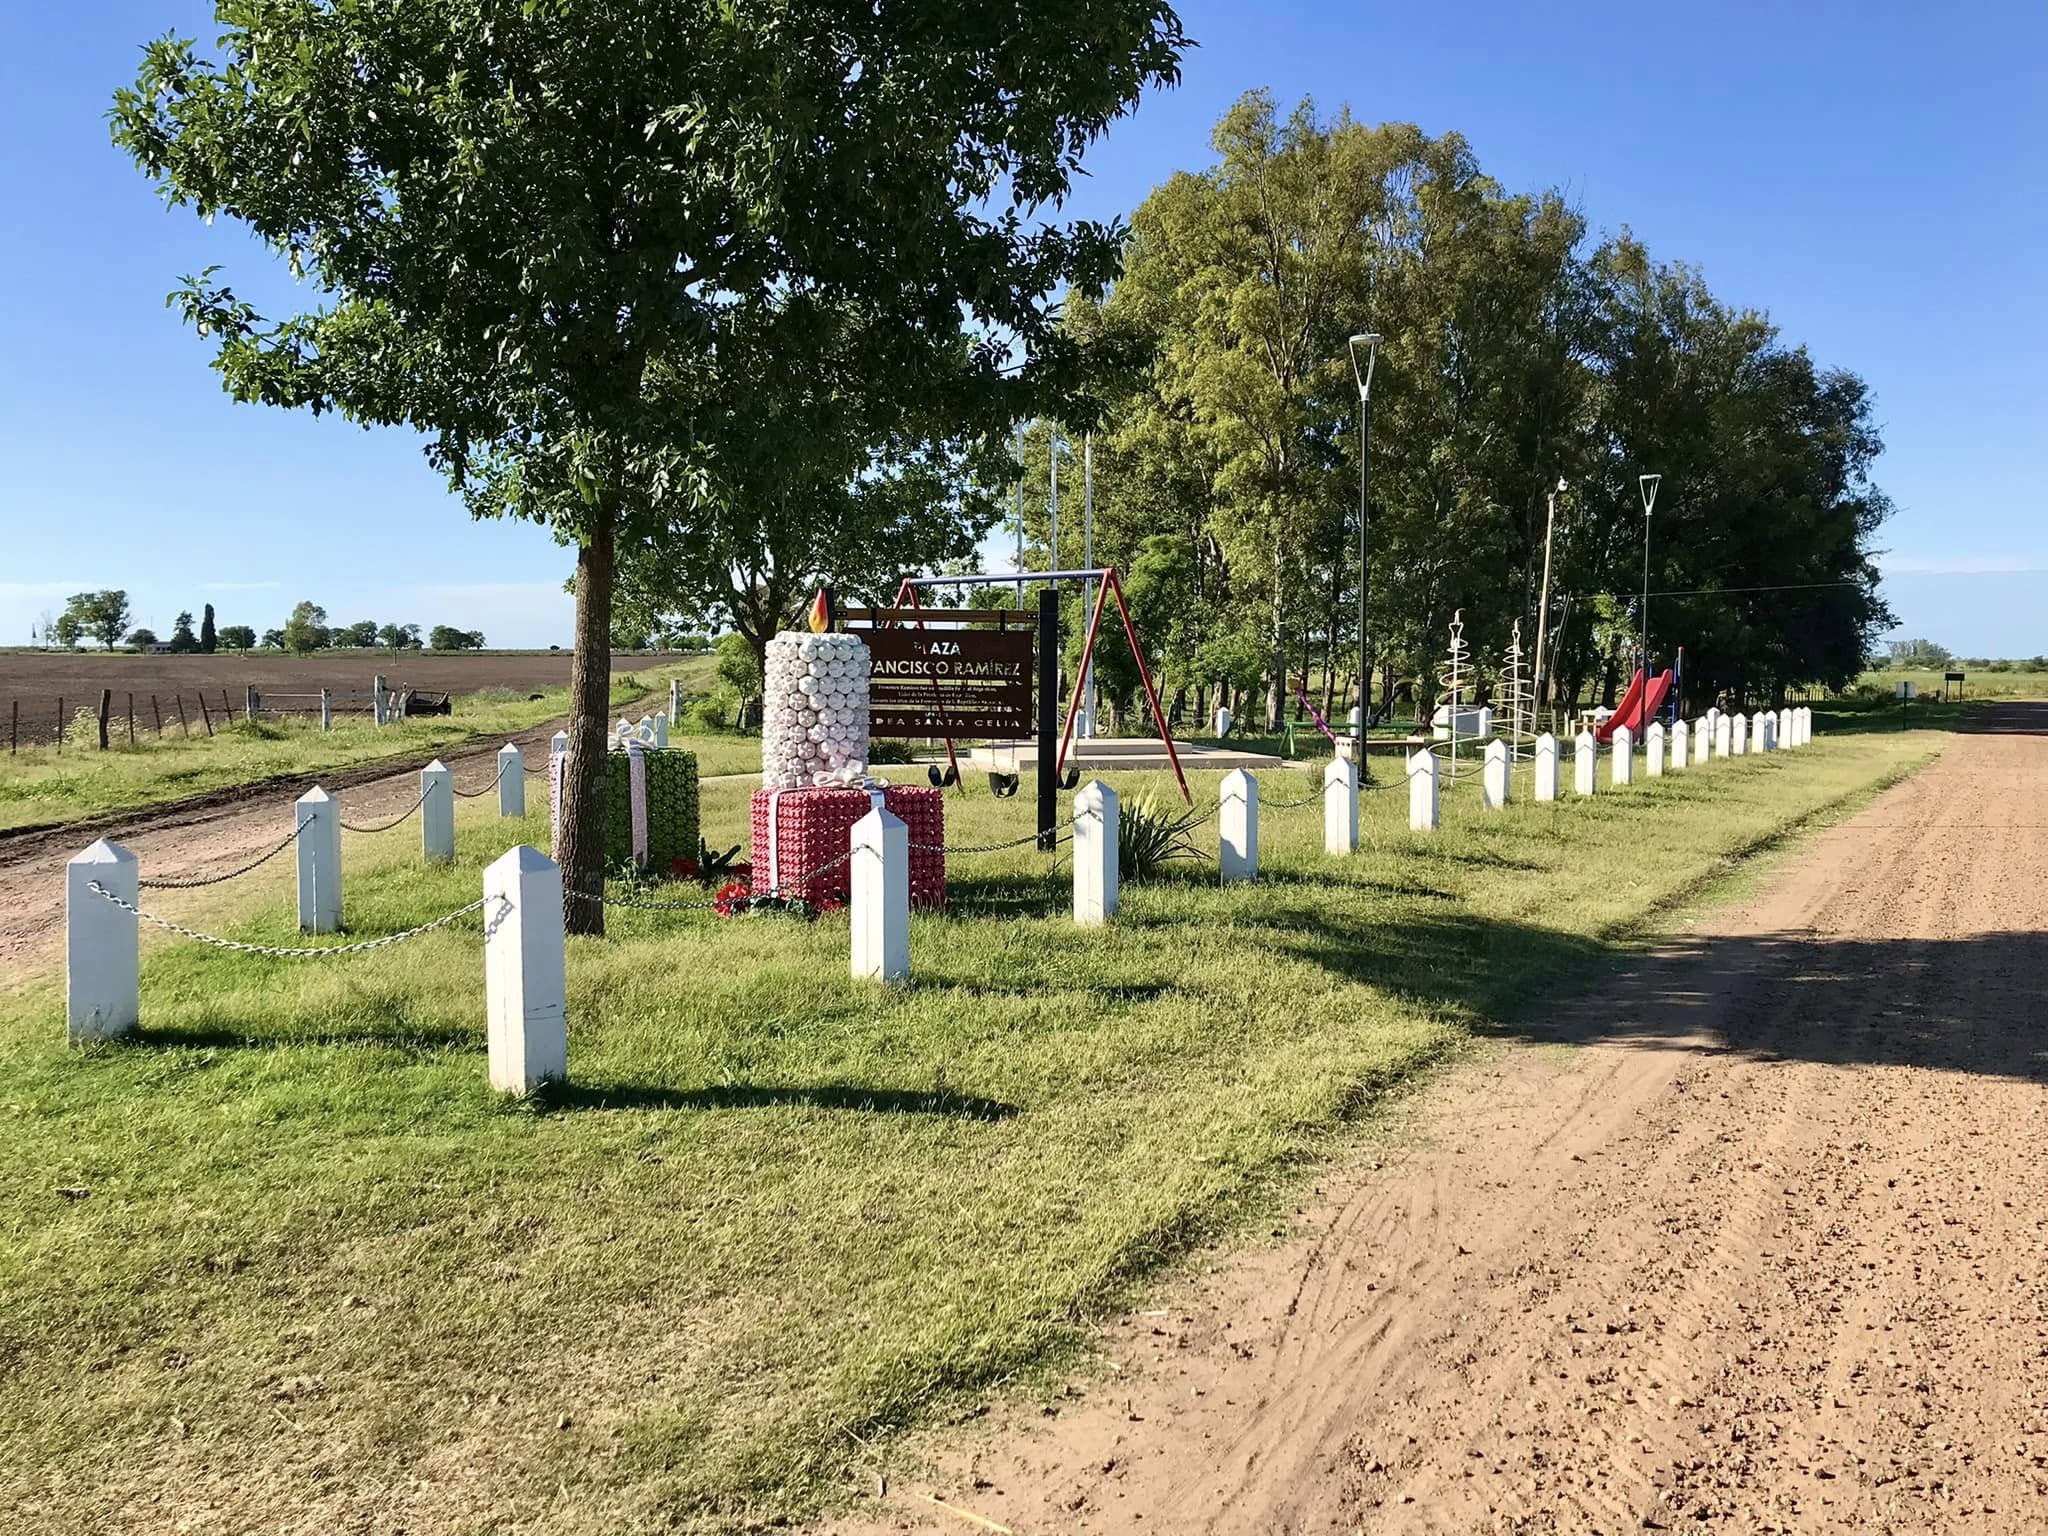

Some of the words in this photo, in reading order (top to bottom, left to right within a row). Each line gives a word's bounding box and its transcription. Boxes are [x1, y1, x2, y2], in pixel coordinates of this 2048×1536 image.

[869, 659, 949, 675] ANCISCO
[914, 717, 966, 728] SANTA
[973, 718, 1021, 729] CELIA
